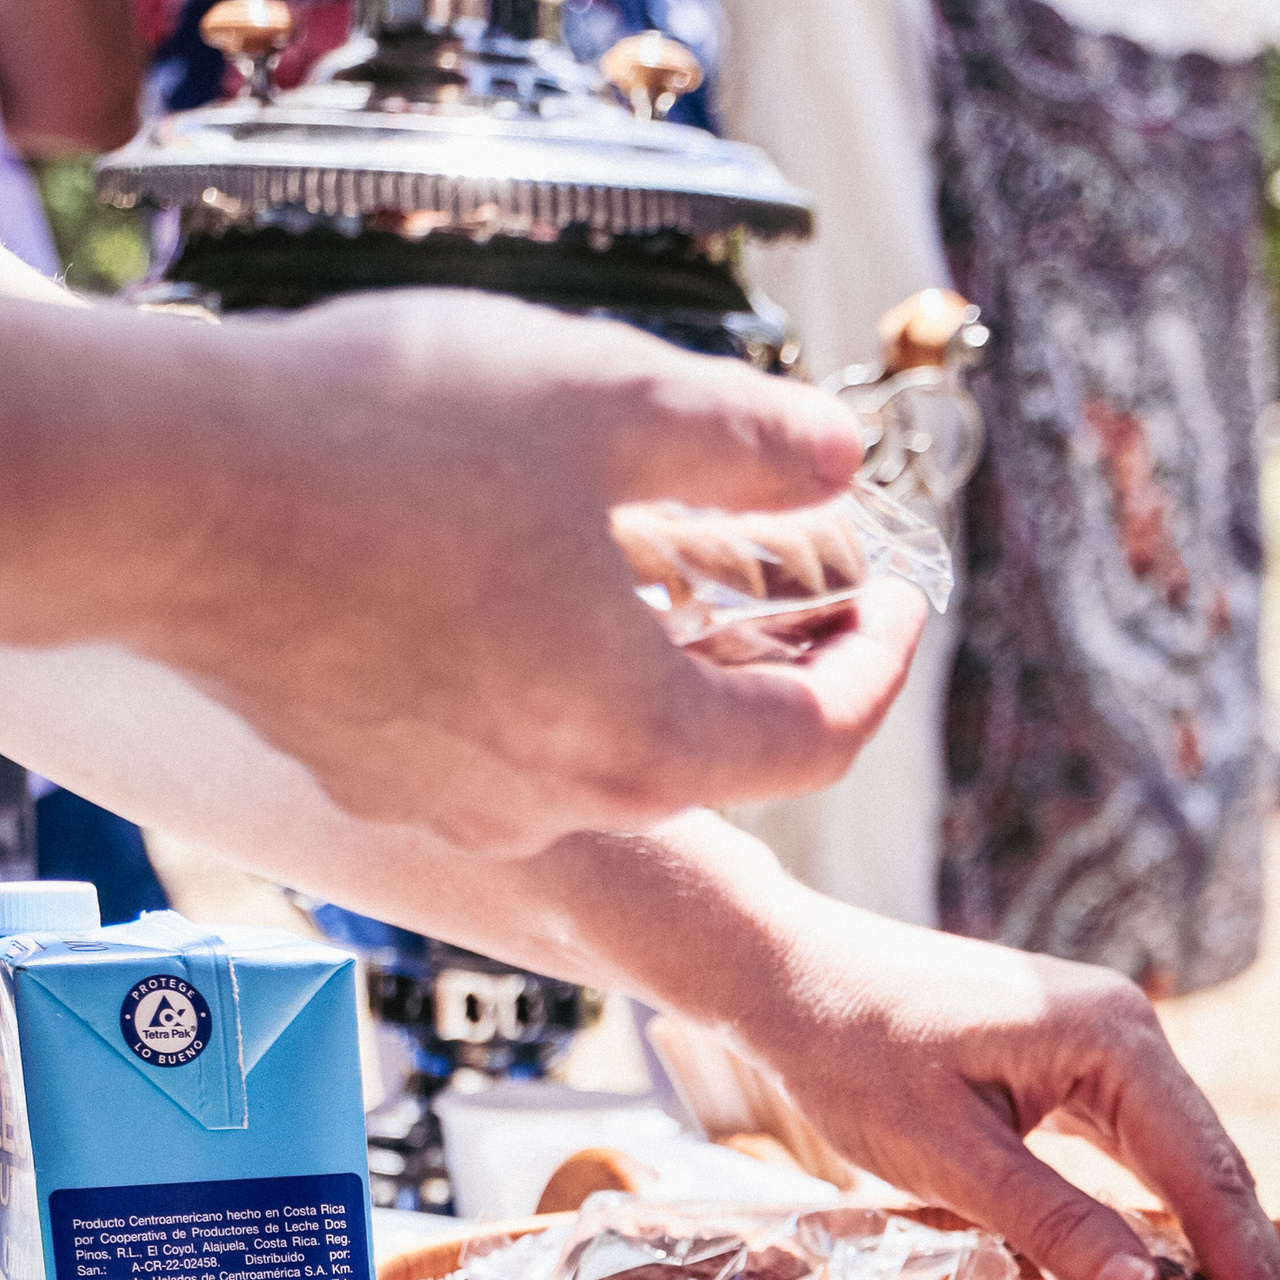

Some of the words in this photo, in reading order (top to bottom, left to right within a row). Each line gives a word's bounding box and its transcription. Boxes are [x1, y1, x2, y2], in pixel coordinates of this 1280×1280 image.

[131, 978, 195, 1000] PROTEGE
[142, 1030, 170, 1039] Tetra
[134, 1042, 152, 1058] LO
[158, 1040, 203, 1064] BUENO
[72, 1217, 125, 1229] Producto
[128, 1212, 222, 1226] Centroamericano
[226, 1209, 261, 1220] hecho
[265, 1209, 279, 1218] en
[283, 1206, 316, 1217] Costa
[320, 1204, 345, 1214] Rica
[77, 1265, 106, 1275] San.:
[131, 1256, 220, 1272] A-CR-22-02458.
[244, 1251, 304, 1265] Distribuido
[329, 1250, 350, 1261] por:
[304, 1265, 327, 1276] S.A.
[331, 1263, 353, 1274] Km.
